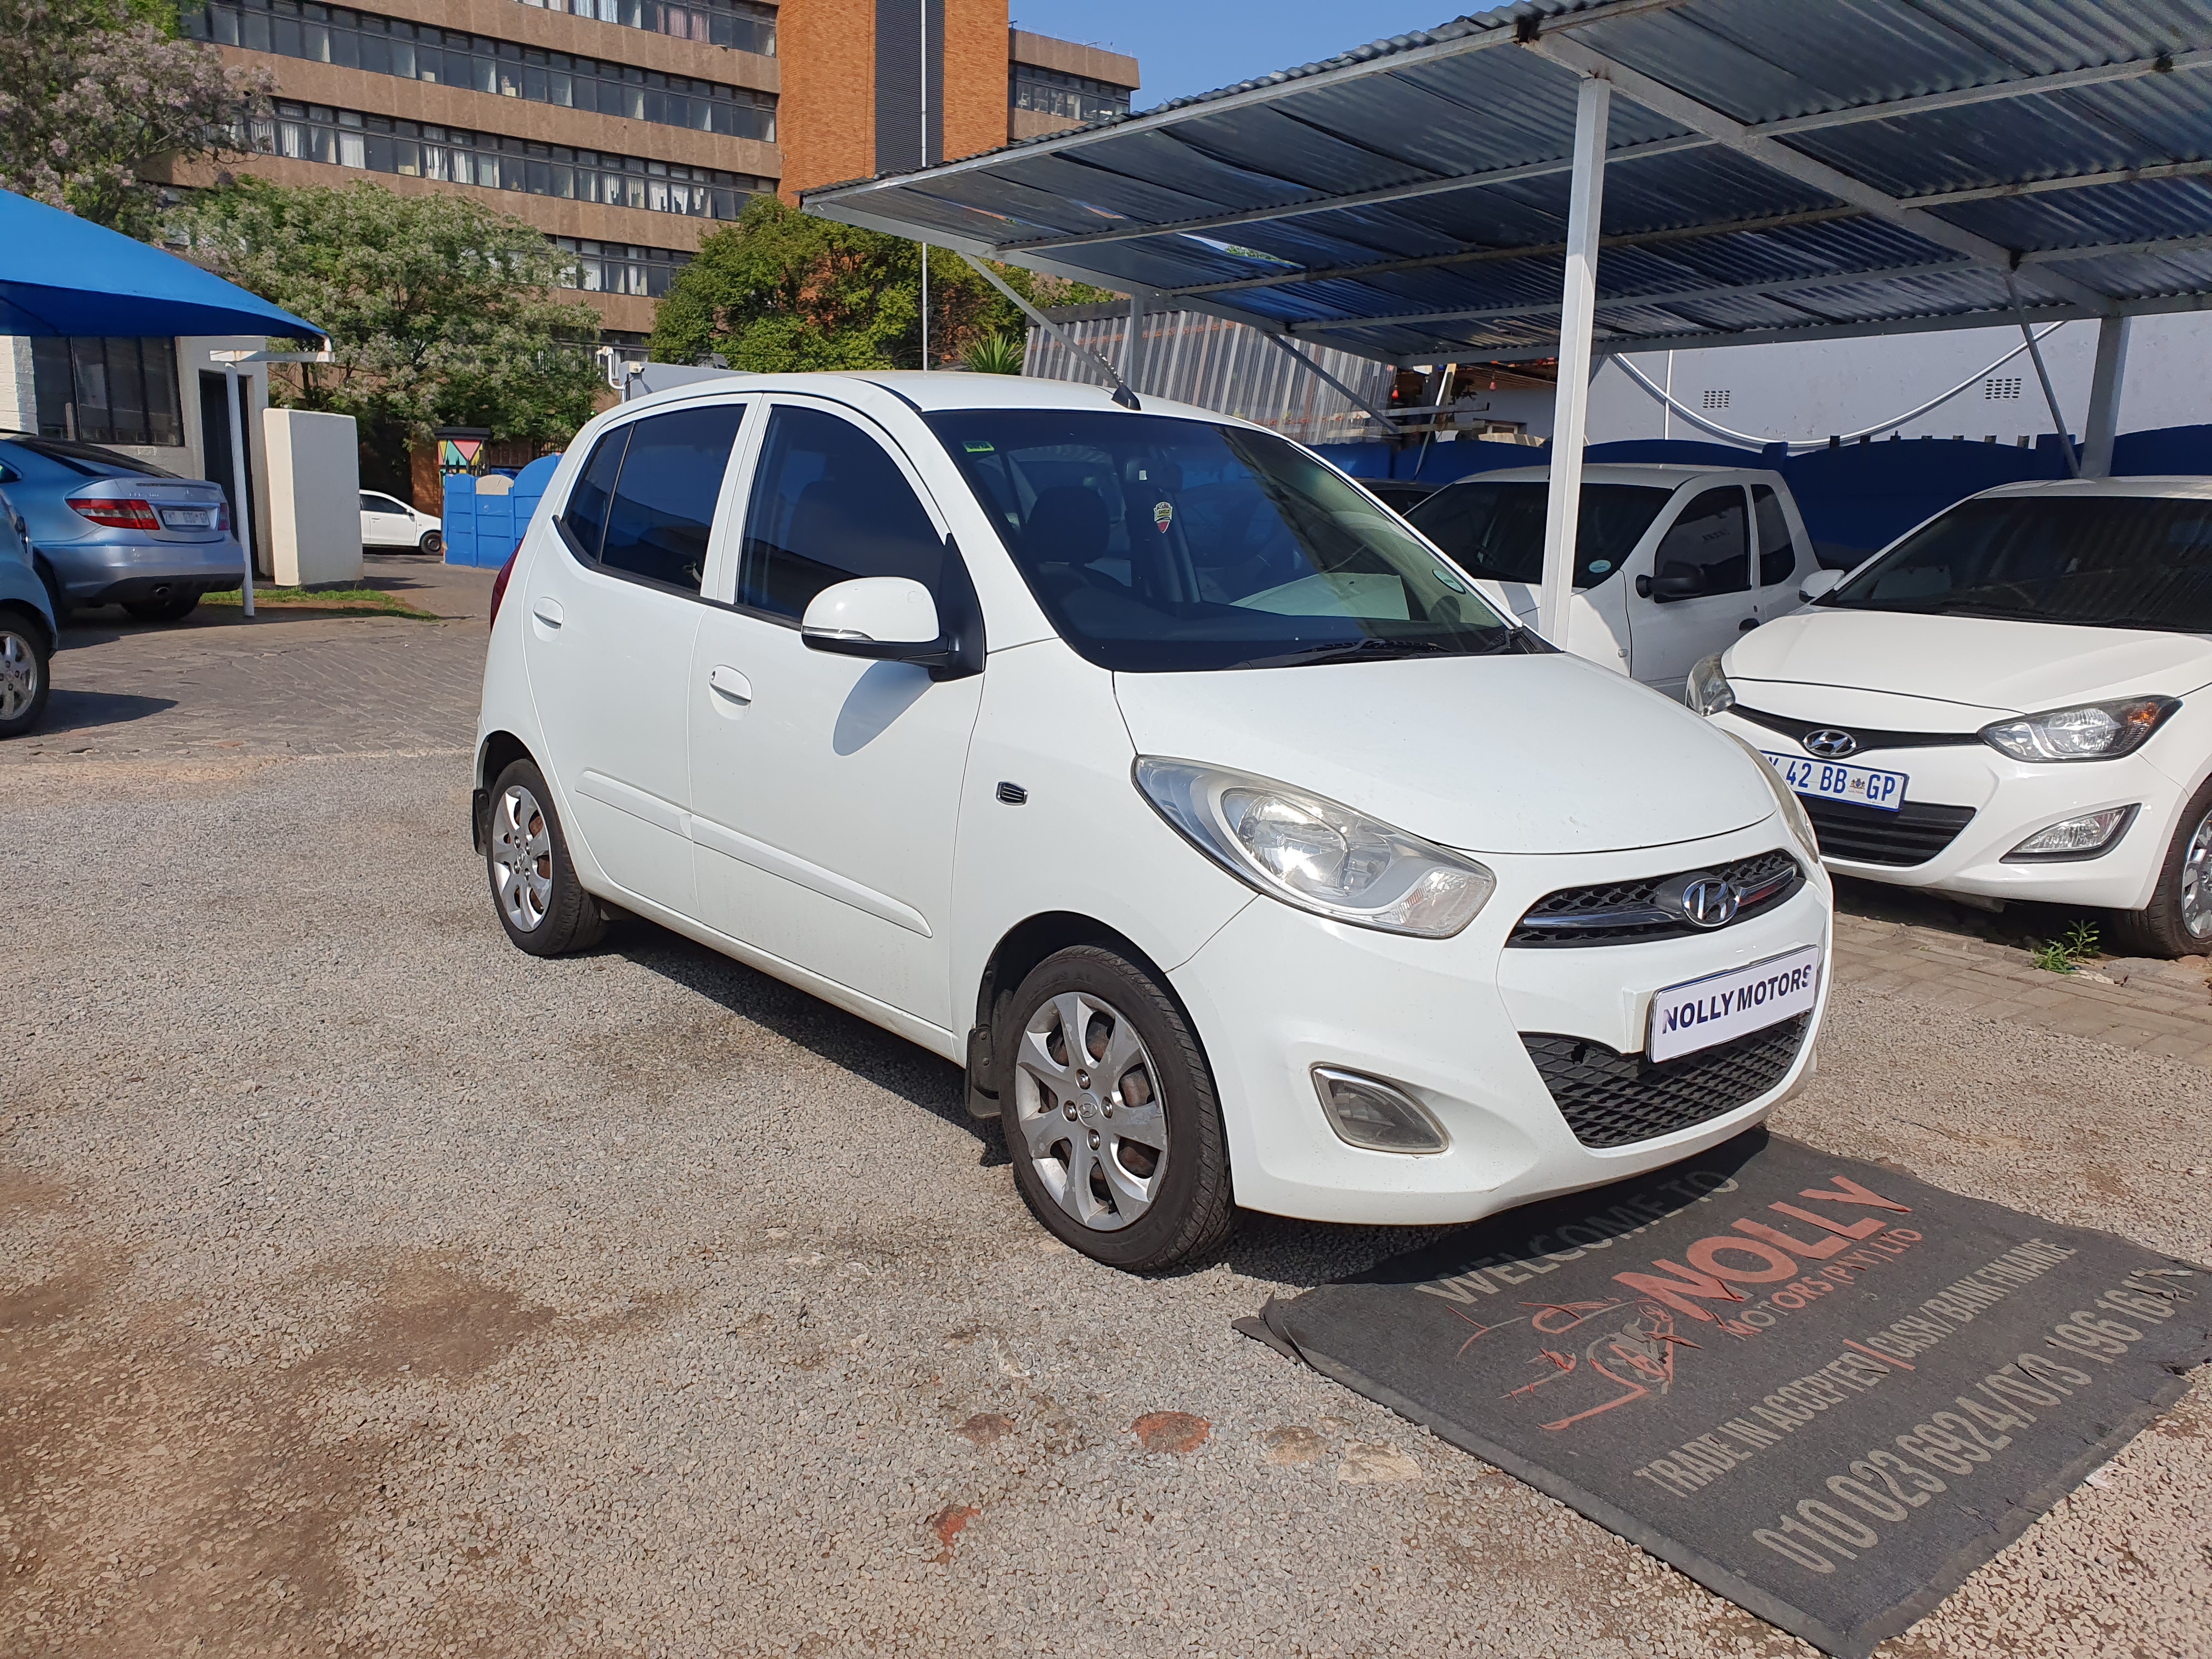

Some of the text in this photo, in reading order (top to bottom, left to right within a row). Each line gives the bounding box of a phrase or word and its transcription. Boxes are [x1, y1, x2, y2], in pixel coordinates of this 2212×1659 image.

[1786, 760, 1895, 801] 42 BB GP
[1662, 964, 1812, 1034] NOLLY MOTORS
[1414, 1170, 1739, 1304] WELCOME TO
[1612, 1175, 1912, 1322] NOLLY
[1973, 1237, 2076, 1288] FINANCE
[1719, 1277, 1834, 1340] MOTORS
[1747, 1350, 1888, 1432] ACCEPTED
[1632, 1434, 1754, 1498] TRADE
[1716, 1417, 1783, 1451] IN
[1752, 1498, 1877, 1573] 010
[1826, 1451, 1947, 1521] 023
[2041, 1310, 2143, 1363] 196
